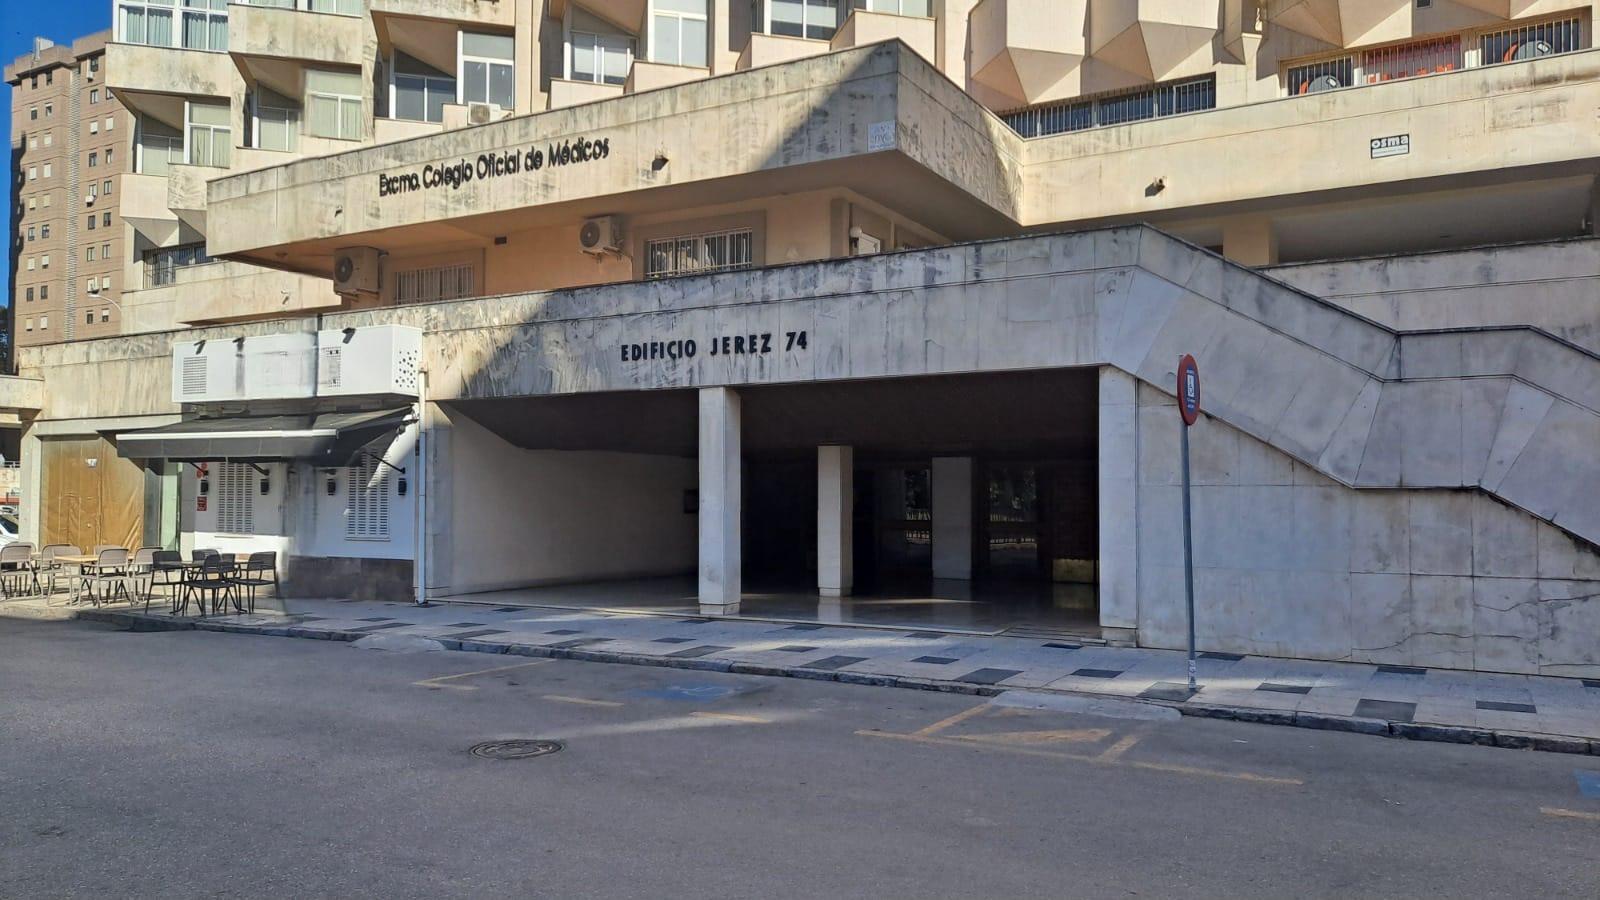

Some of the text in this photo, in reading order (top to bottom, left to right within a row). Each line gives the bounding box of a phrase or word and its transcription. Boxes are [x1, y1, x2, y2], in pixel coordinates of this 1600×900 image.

[1371, 136, 1408, 148] osma
[422, 158, 474, 190] Colegio
[476, 149, 520, 180] Oficial
[524, 145, 544, 172] de
[547, 136, 609, 168] Médicos
[620, 330, 808, 362] EDIFICIO JEREZ 74
